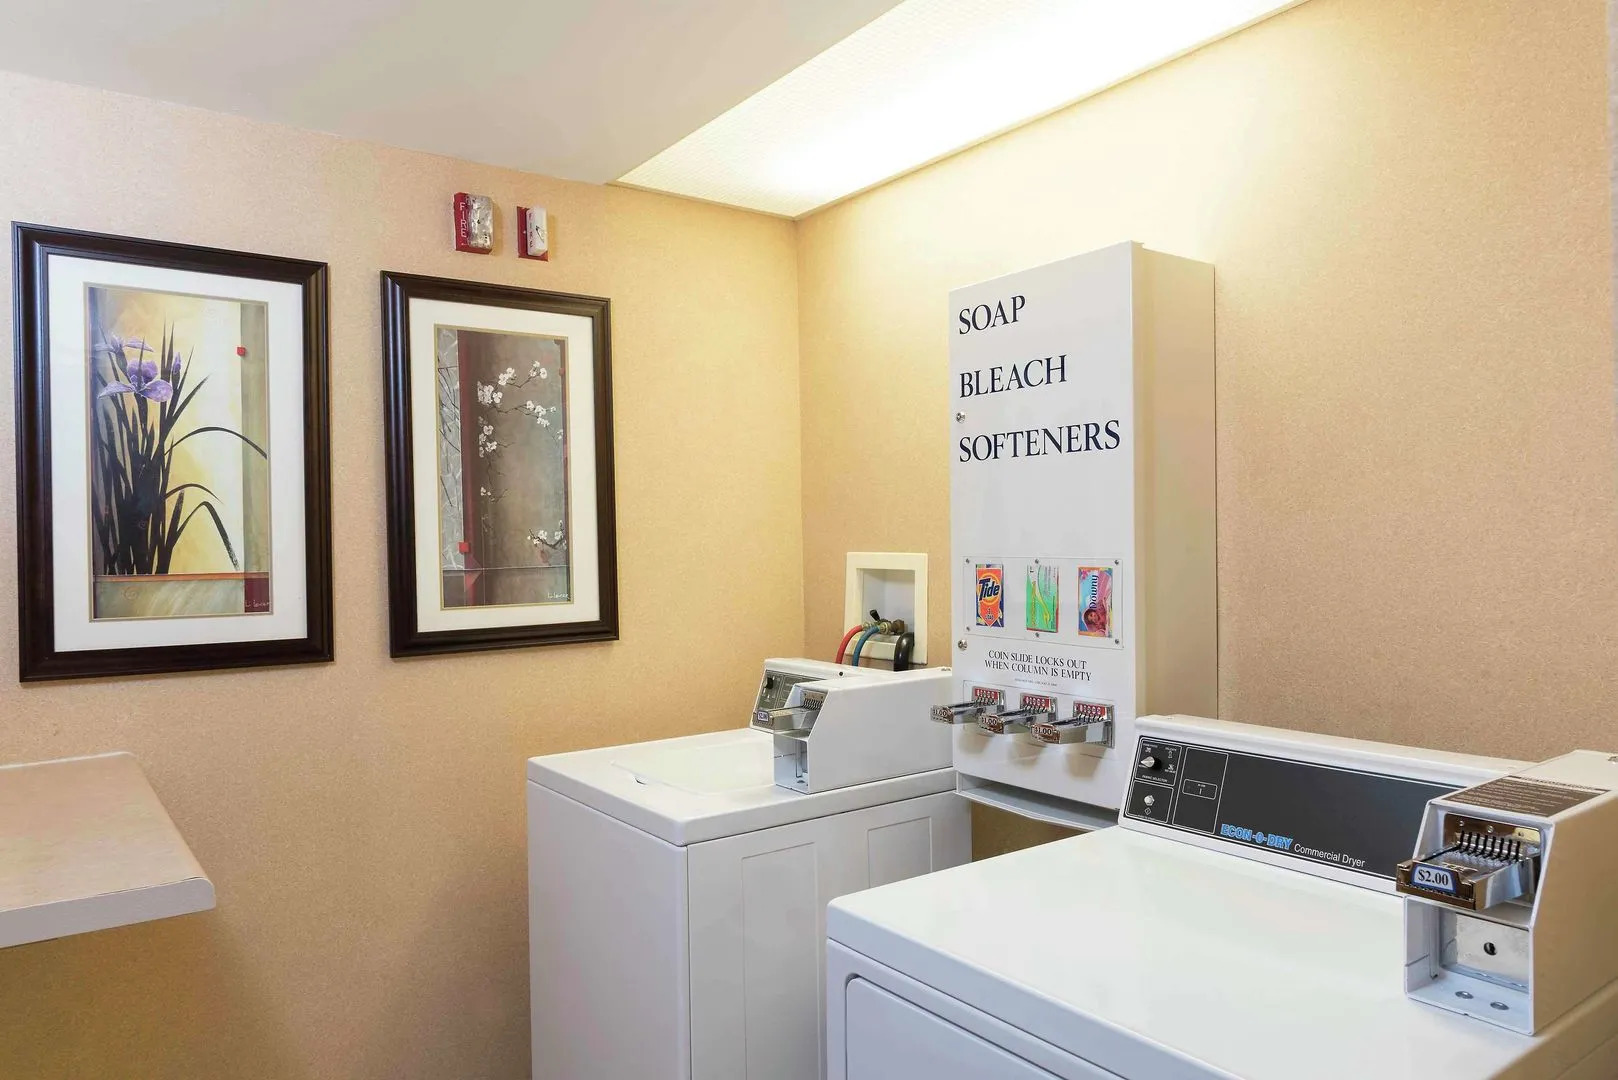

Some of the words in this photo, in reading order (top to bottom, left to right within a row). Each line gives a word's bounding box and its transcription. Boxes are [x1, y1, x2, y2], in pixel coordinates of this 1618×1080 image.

[459, 202, 468, 238] FIRE
[959, 295, 1026, 335] SOAP
[959, 354, 1067, 399] BLEACH
[959, 419, 1121, 463] SOFTENERS
[978, 577, 1001, 601] Tide
[1088, 574, 1100, 610] Downy
[985, 659, 1009, 670] WHEN
[1012, 664, 1048, 675] COLUMN
[1051, 668, 1058, 677] IS
[1061, 669, 1092, 682] EMPTY
[988, 650, 1009, 660] COIN
[1011, 652, 1033, 664] SLIDE
[1035, 655, 1064, 667] LOCKS
[1067, 659, 1087, 670] OUT
[1034, 727, 1053, 736] $1.00
[1220, 824, 1293, 849] ECON-O-DRY
[1294, 843, 1341, 862] Commercial
[1341, 853, 1366, 869] Dryer
[1418, 869, 1450, 887] $2.00
